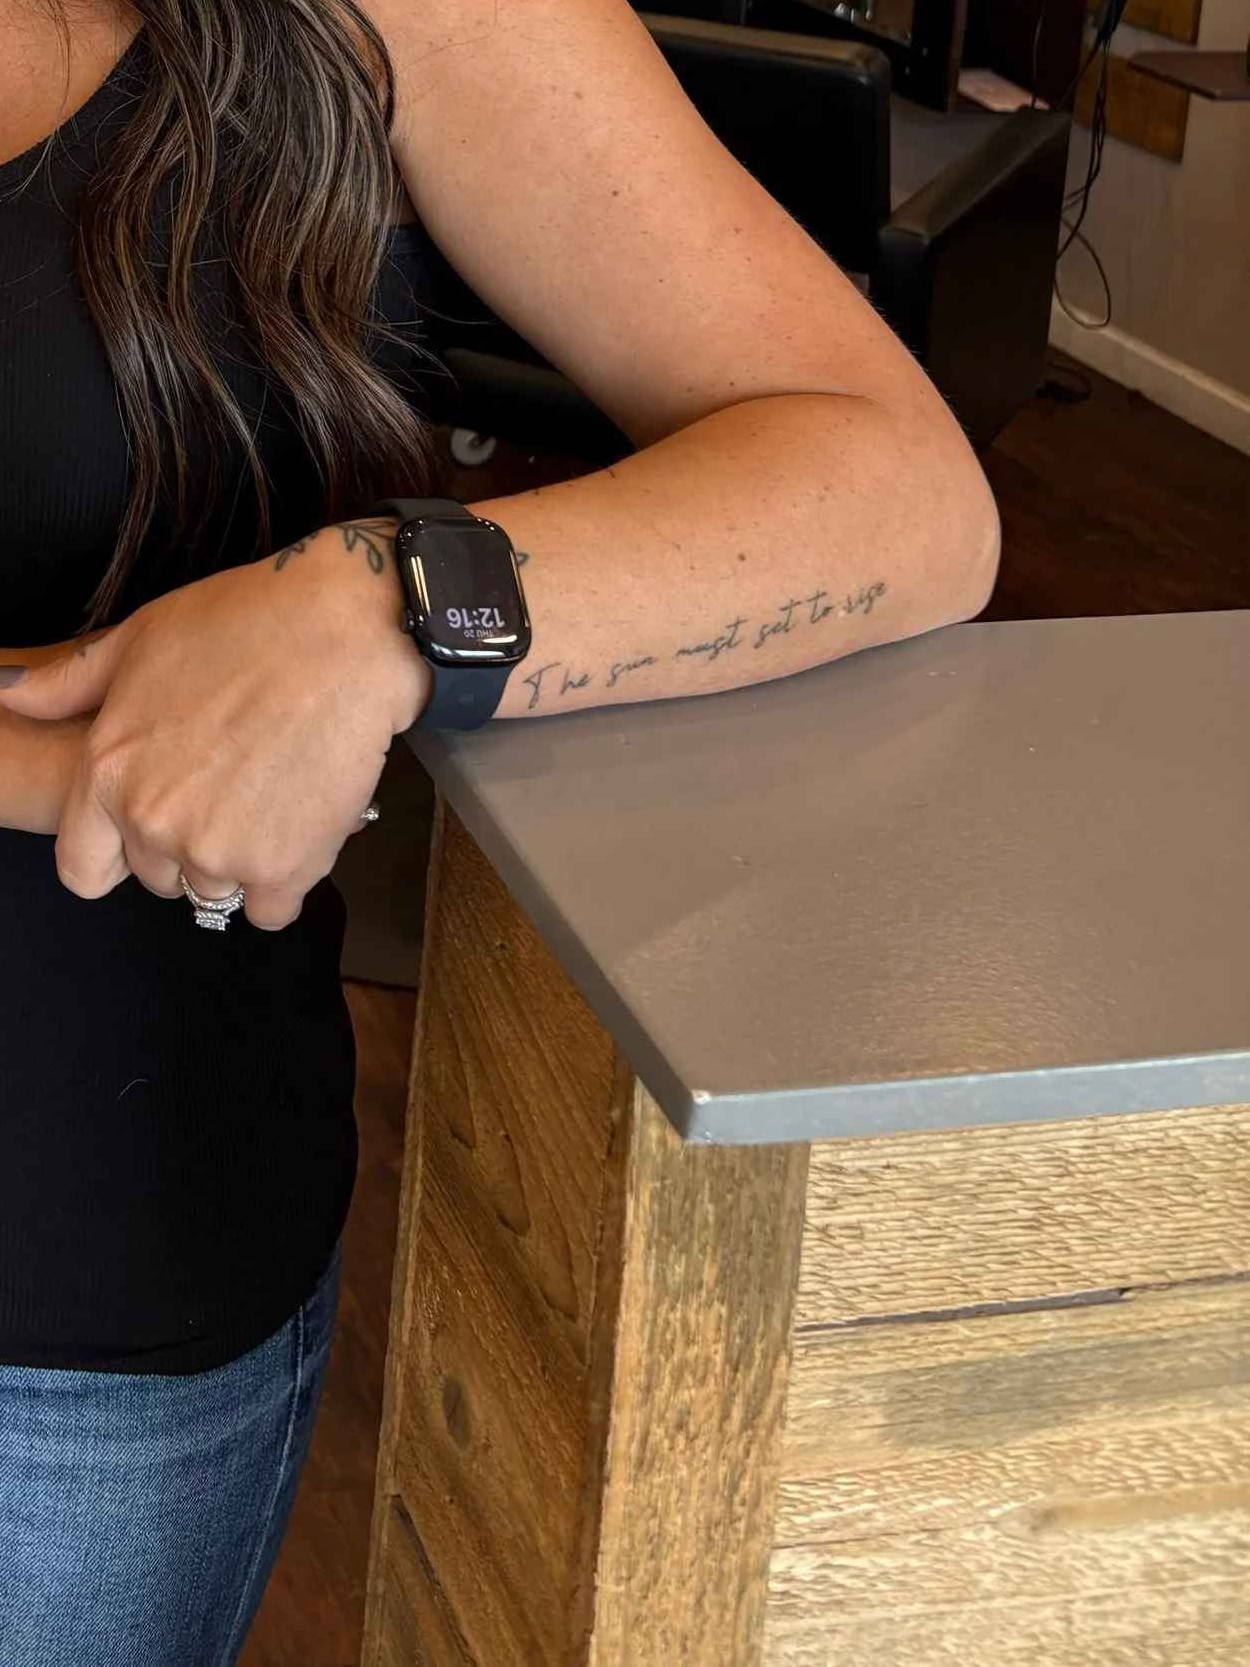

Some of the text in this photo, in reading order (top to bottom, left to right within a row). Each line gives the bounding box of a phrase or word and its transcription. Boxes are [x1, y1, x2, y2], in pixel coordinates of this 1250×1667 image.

[446, 607, 505, 629] 12:16
[463, 629, 494, 638] THU 20
[522, 662, 592, 709] The
[606, 656, 660, 688] sun
[676, 615, 749, 661] must
[753, 598, 802, 650] set
[806, 589, 834, 624] to
